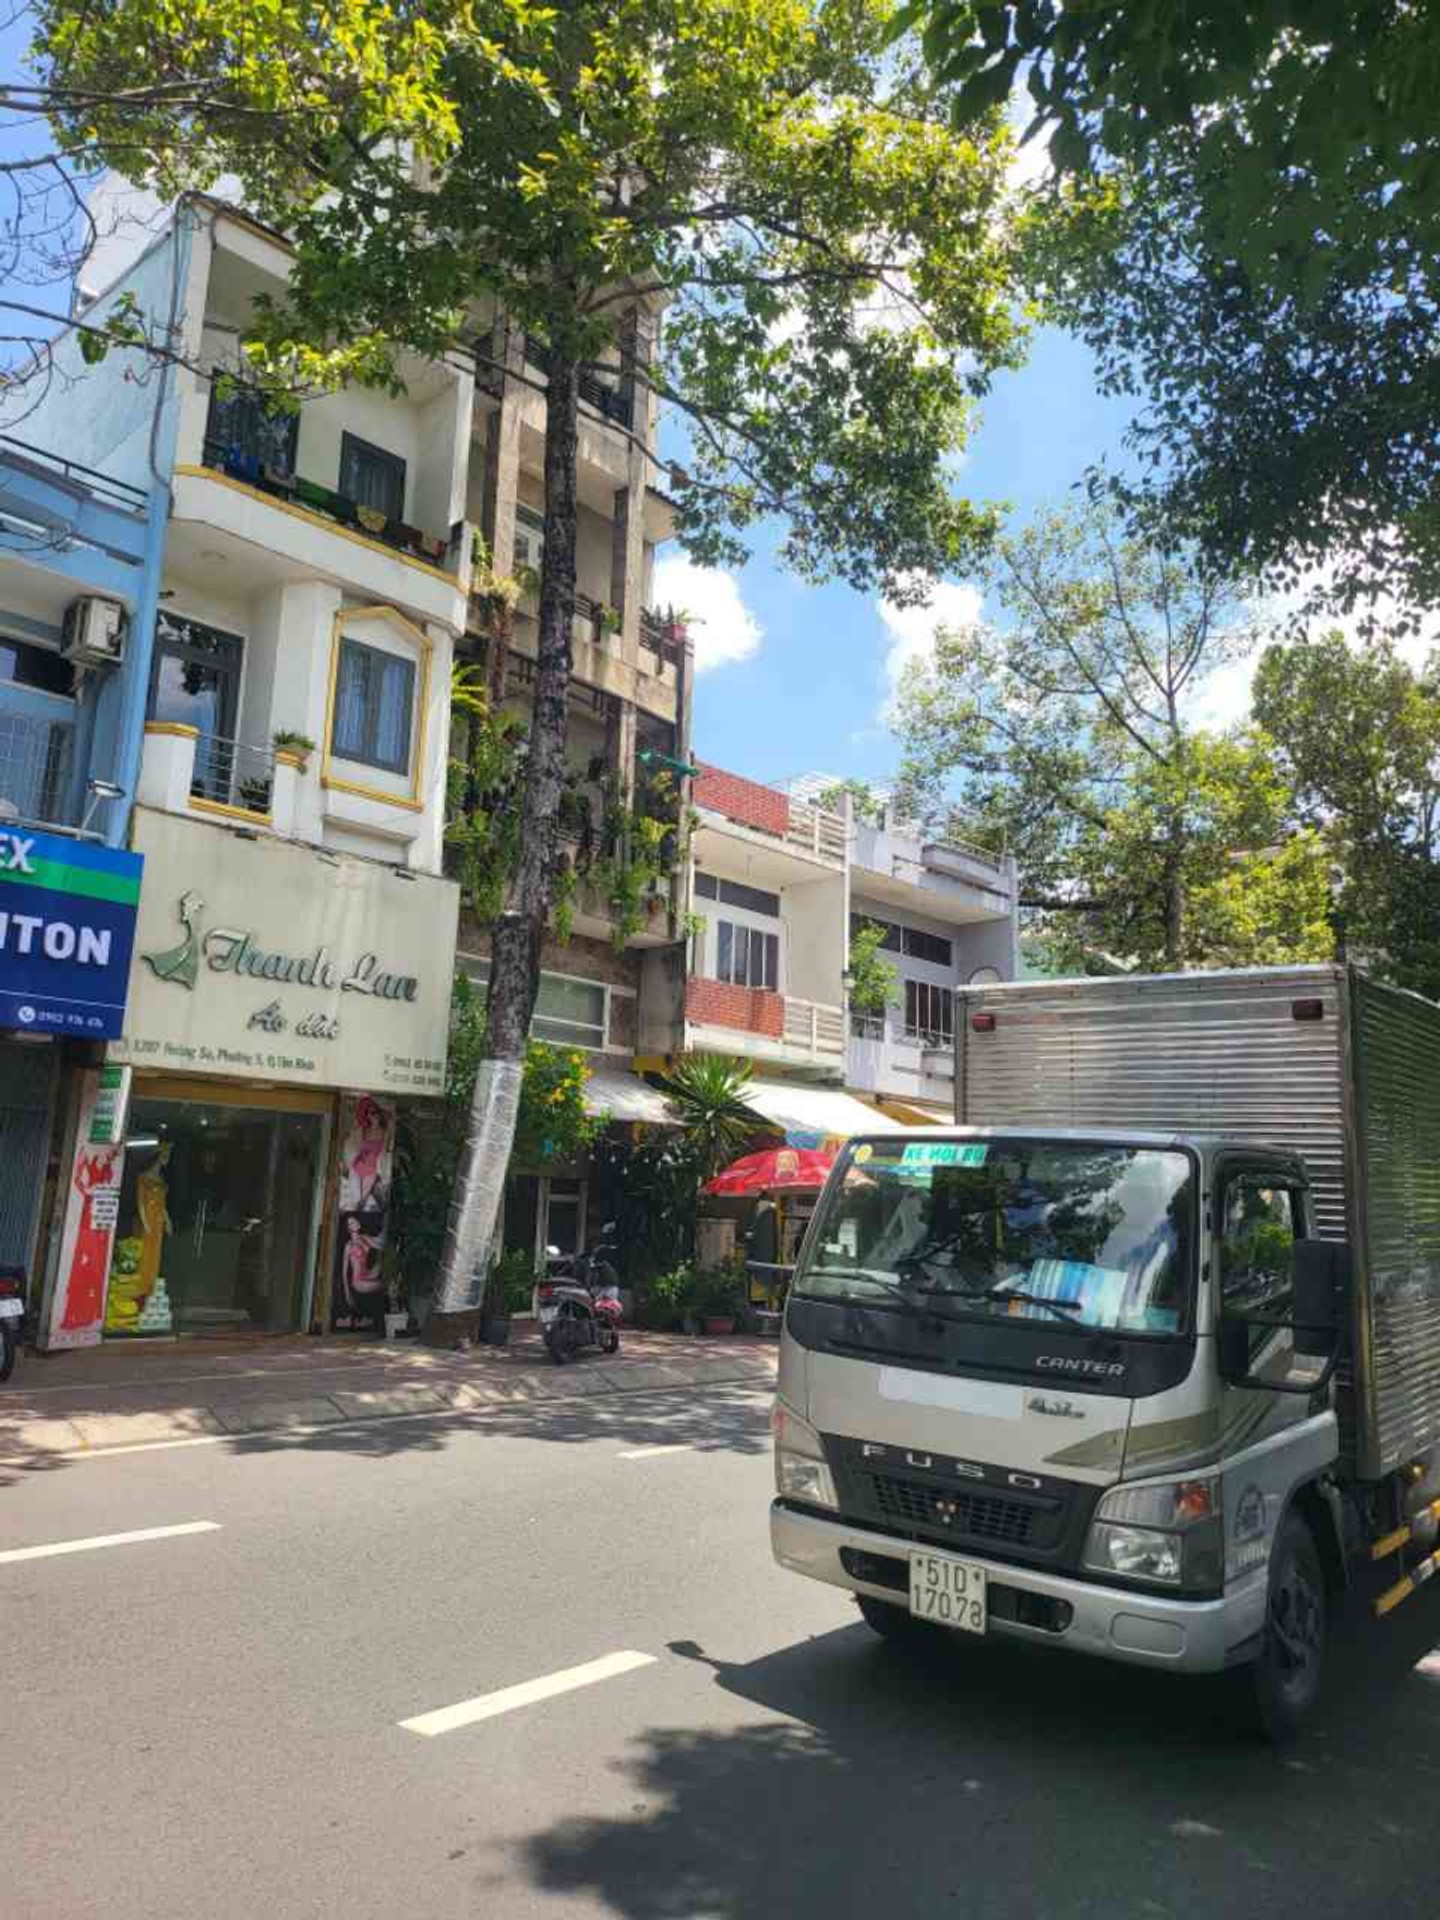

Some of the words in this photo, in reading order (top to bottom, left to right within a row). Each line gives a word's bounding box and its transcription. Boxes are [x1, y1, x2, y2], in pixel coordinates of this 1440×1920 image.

[203, 927, 337, 989] Thanh
[341, 952, 418, 1002] Lan
[1036, 1355, 1125, 1376] CANTER
[863, 1443, 1042, 1490] FUSO
[926, 1559, 967, 1593] 51D
